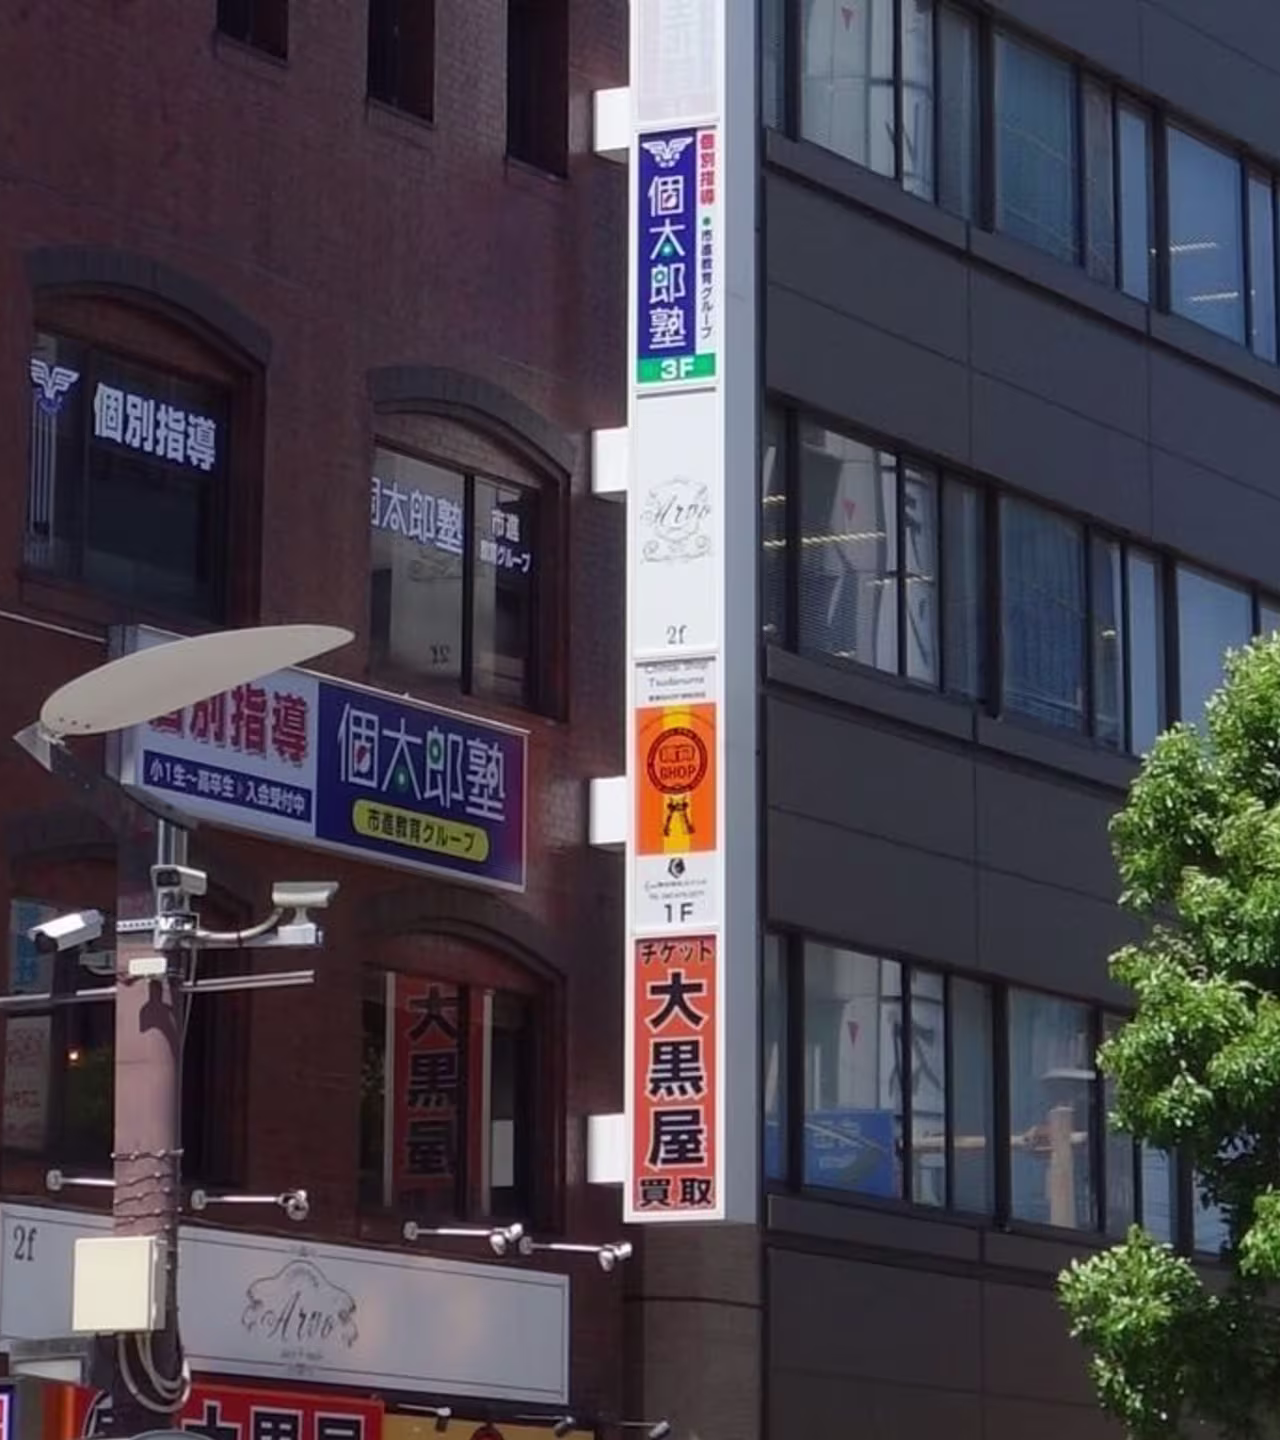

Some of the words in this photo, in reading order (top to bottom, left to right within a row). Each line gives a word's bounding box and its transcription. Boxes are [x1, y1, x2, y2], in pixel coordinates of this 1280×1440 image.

[647, 175, 688, 351] 個太郎塾
[660, 358, 695, 380] 3F
[94, 382, 216, 471] 個別指導
[337, 703, 506, 821] 個太郎塾
[367, 807, 477, 854] 市進教育グループ
[664, 902, 694, 923] 1F
[641, 940, 713, 966] チケット
[405, 982, 458, 1178] 大黒屋
[645, 971, 705, 1168] 大黒屋
[638, 1176, 713, 1207] 買取
